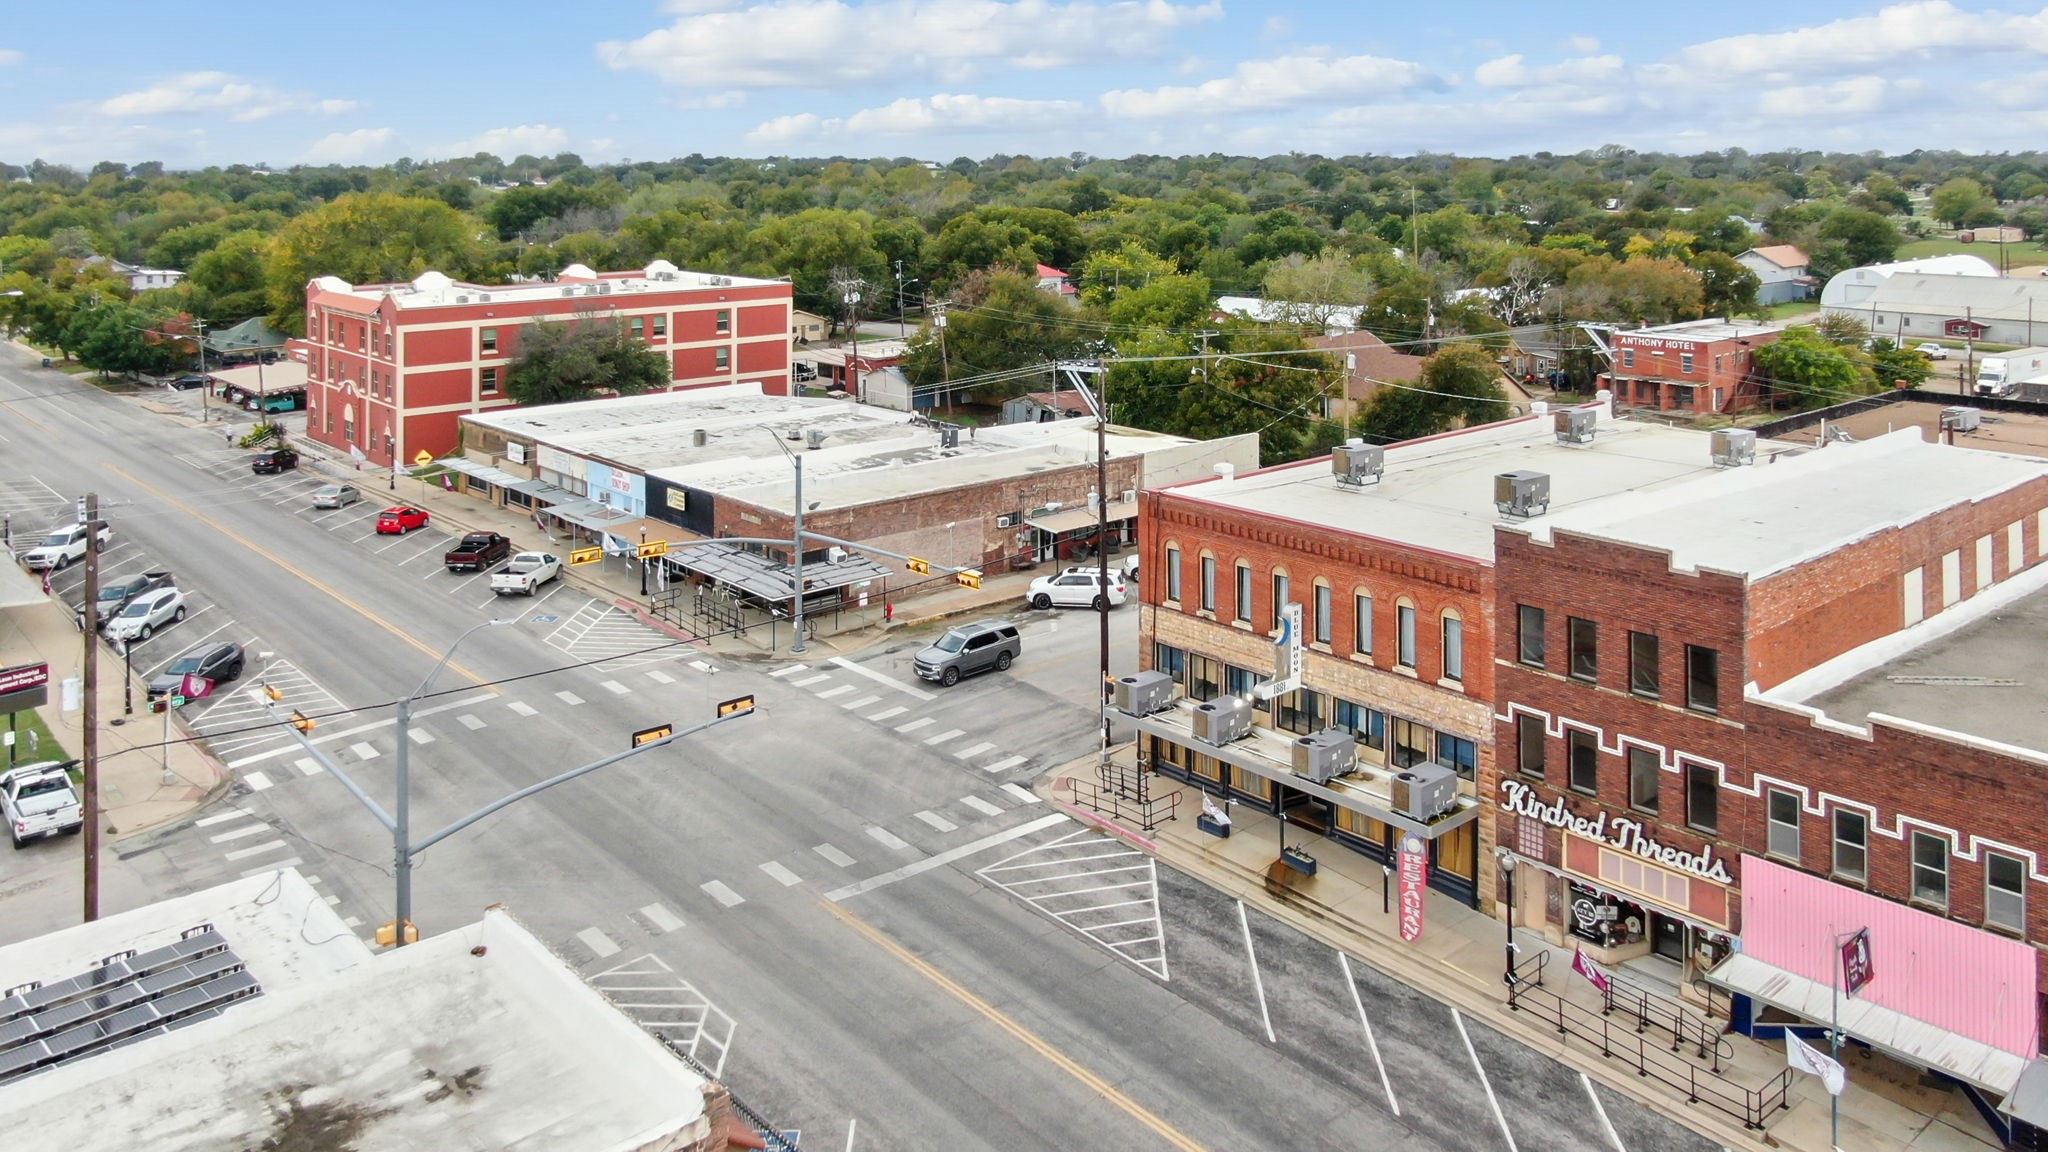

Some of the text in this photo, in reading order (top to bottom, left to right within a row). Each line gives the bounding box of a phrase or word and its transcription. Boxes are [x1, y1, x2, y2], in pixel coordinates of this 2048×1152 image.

[1620, 336, 1696, 350] ANTHONY HOTEL
[13, 669, 40, 680] Industrial
[1273, 681, 1286, 695] 1881
[1500, 780, 1733, 884] Kindred Threads
[1402, 852, 1422, 941] RESTAURANT
